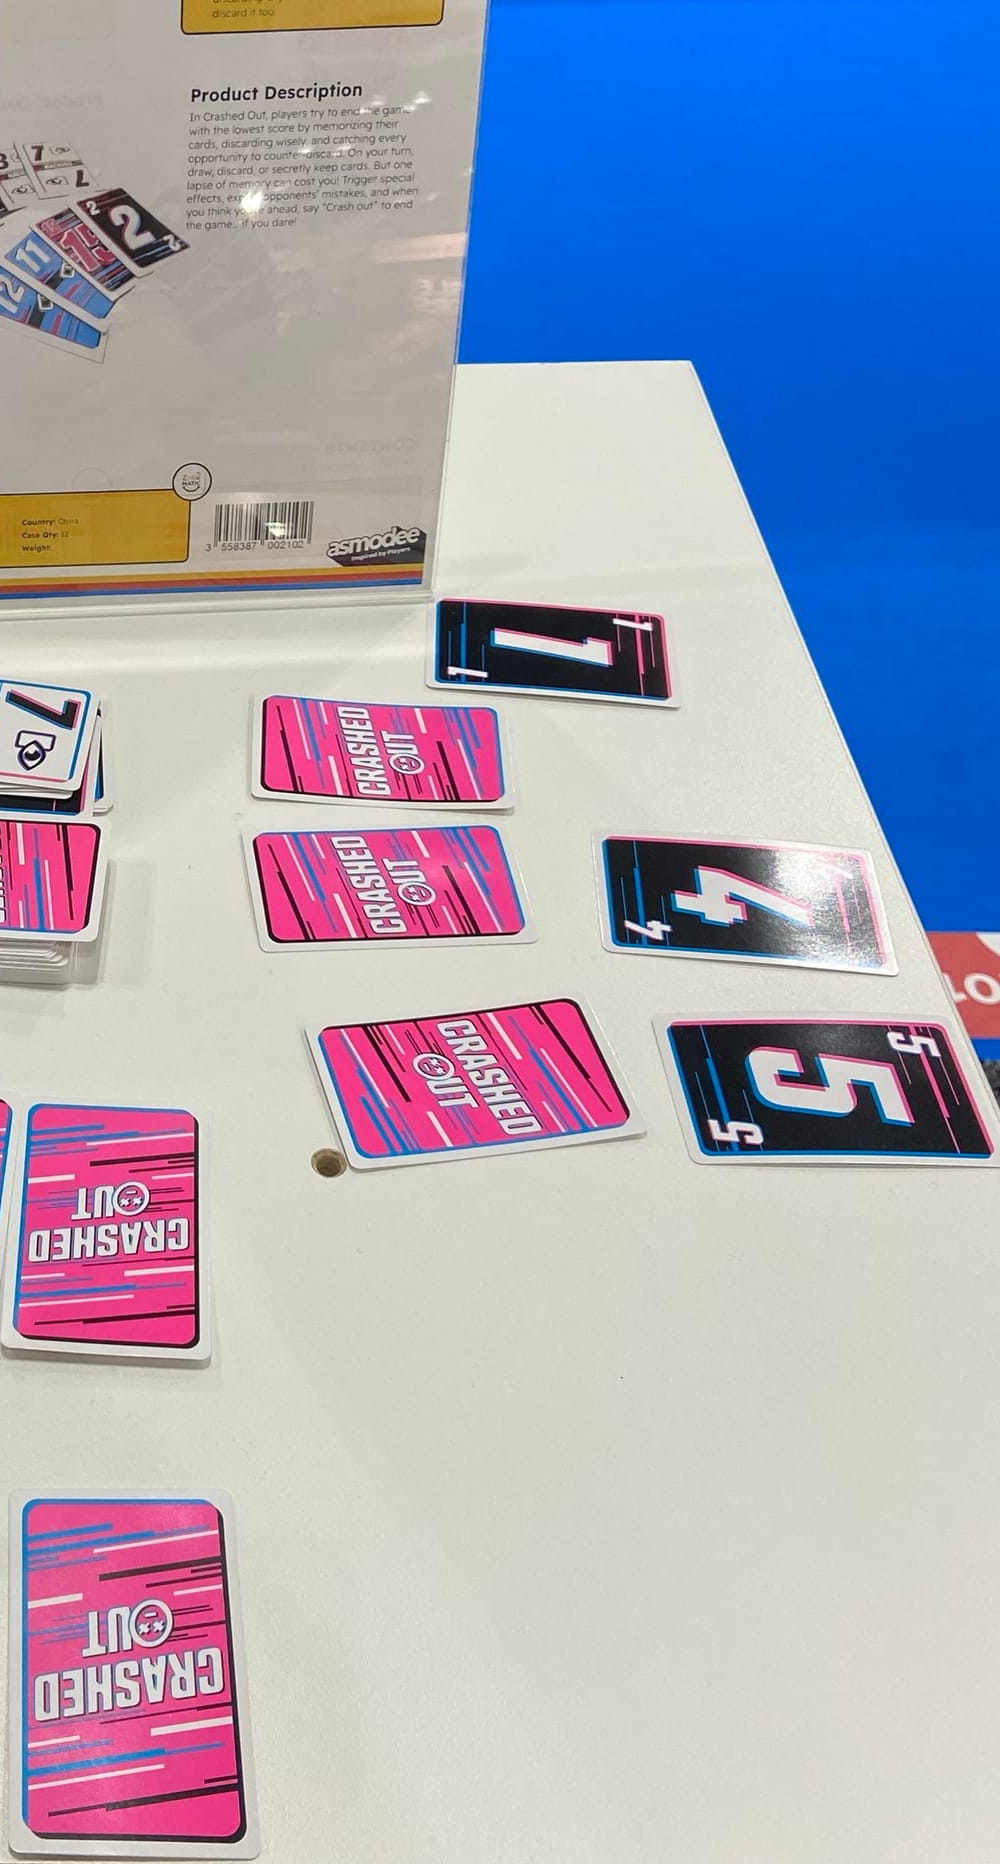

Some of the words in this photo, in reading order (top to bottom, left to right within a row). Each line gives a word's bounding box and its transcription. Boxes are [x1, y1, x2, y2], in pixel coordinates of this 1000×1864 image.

[212, 8, 247, 19] discard
[191, 87, 259, 102] Product
[264, 82, 363, 102] Description
[189, 113, 200, 122] In
[204, 111, 245, 122] Crashed
[247, 111, 268, 120] Out,
[271, 110, 307, 121] players
[311, 109, 324, 119] try
[328, 109, 337, 117] to
[341, 107, 360, 115] end
[189, 127, 210, 136] with
[214, 126, 229, 135] the
[233, 125, 264, 135] lowest
[267, 125, 294, 133] score
[297, 123, 310, 133] by
[313, 121, 372, 132] memorizing
[376, 120, 398, 128] their
[30, 145, 46, 161] 7
[188, 140, 218, 150] cards,
[222, 138, 273, 149] discarding
[312, 136, 329, 145] and
[333, 135, 375, 145] catching
[379, 135, 407, 143] every
[188, 154, 248, 164] opportunity
[251, 153, 261, 161] to
[348, 148, 362, 157] On
[365, 148, 388, 158] your
[392, 147, 413, 157] turn,
[75, 169, 90, 187] 7
[187, 168, 214, 177] draw,
[217, 166, 256, 176] discard,
[259, 166, 269, 174] or
[272, 164, 311, 174] secretly
[314, 164, 338, 173] keep
[341, 162, 368, 171] cards.
[374, 161, 391, 170] But
[394, 161, 412, 169] one
[187, 181, 213, 191] lapse
[216, 181, 226, 189] of
[295, 178, 315, 186] cost
[319, 177, 339, 186] you!
[343, 175, 378, 186] Trigger
[380, 174, 415, 184] special
[186, 195, 224, 204] effects,
[322, 189, 368, 198] mistakes,
[371, 187, 389, 196] and
[392, 186, 419, 196] when
[85, 200, 100, 217] 2
[186, 209, 204, 218] you
[207, 206, 231, 216] think
[268, 205, 299, 214] ahead,
[303, 205, 319, 214] say
[394, 200, 413, 209] end
[108, 205, 157, 249] 2
[186, 221, 202, 230] the
[251, 220, 269, 229] you
[272, 218, 296, 227] dare!
[15, 238, 50, 273] 11
[22, 518, 57, 528] Country:
[22, 531, 41, 539] Case
[42, 531, 60, 541] Qty:
[205, 543, 212, 552] 3
[221, 541, 258, 552] 558387
[268, 540, 304, 550] 002102
[327, 526, 421, 557] asmodee
[22, 543, 53, 553] Weight:
[612, 617, 654, 632] 1
[490, 627, 613, 668] 1
[447, 666, 489, 679] 1
[5, 689, 82, 731] 7
[335, 705, 392, 797] CRASHED
[381, 729, 425, 776] OUT
[330, 835, 408, 935] CRASHED
[384, 858, 437, 907] OUT
[670, 865, 815, 928] 4
[623, 919, 672, 941] 4
[886, 1031, 942, 1058] 5
[412, 1051, 480, 1110] OUT
[436, 1018, 543, 1136] CRASHED
[745, 1046, 916, 1128] 5
[707, 1118, 764, 1146] 5
[70, 1180, 151, 1221] OUT
[28, 1217, 189, 1263] CRASHED
[81, 1596, 176, 1660] OUT
[32, 1646, 227, 1723] CRASHED
